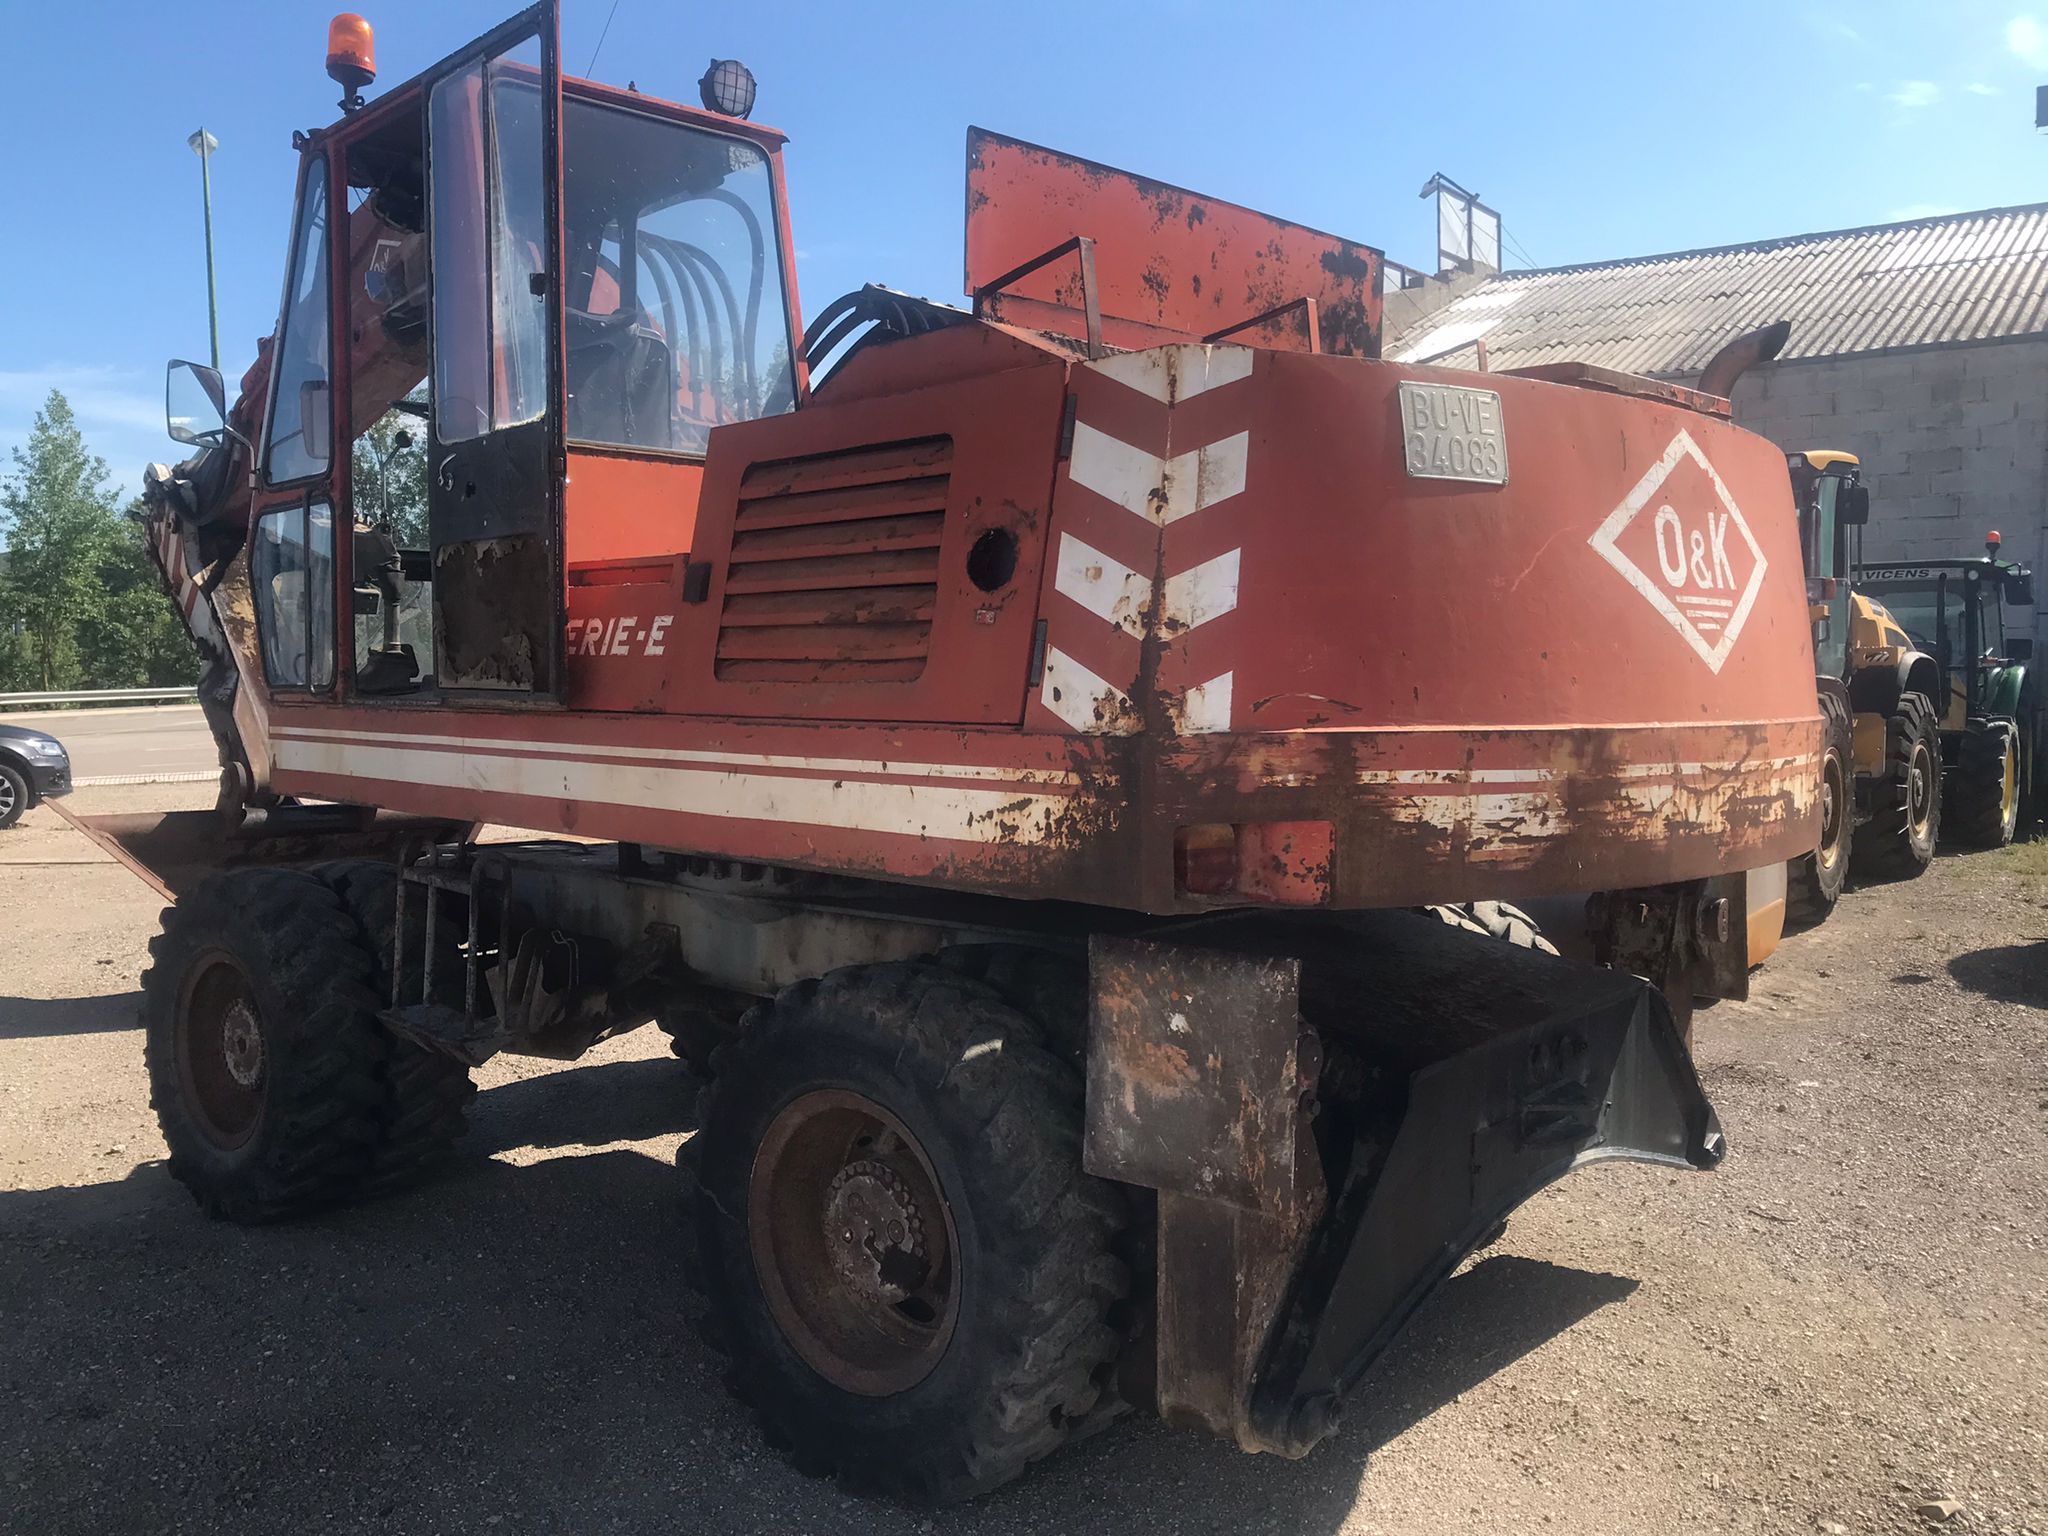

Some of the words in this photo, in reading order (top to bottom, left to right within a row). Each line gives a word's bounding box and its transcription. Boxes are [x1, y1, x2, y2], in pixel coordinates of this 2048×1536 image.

[1411, 389, 1495, 436] BU-VE
[1409, 431, 1498, 478] 34083
[1655, 504, 1737, 590] O&K
[1865, 569, 1930, 580] VICENS
